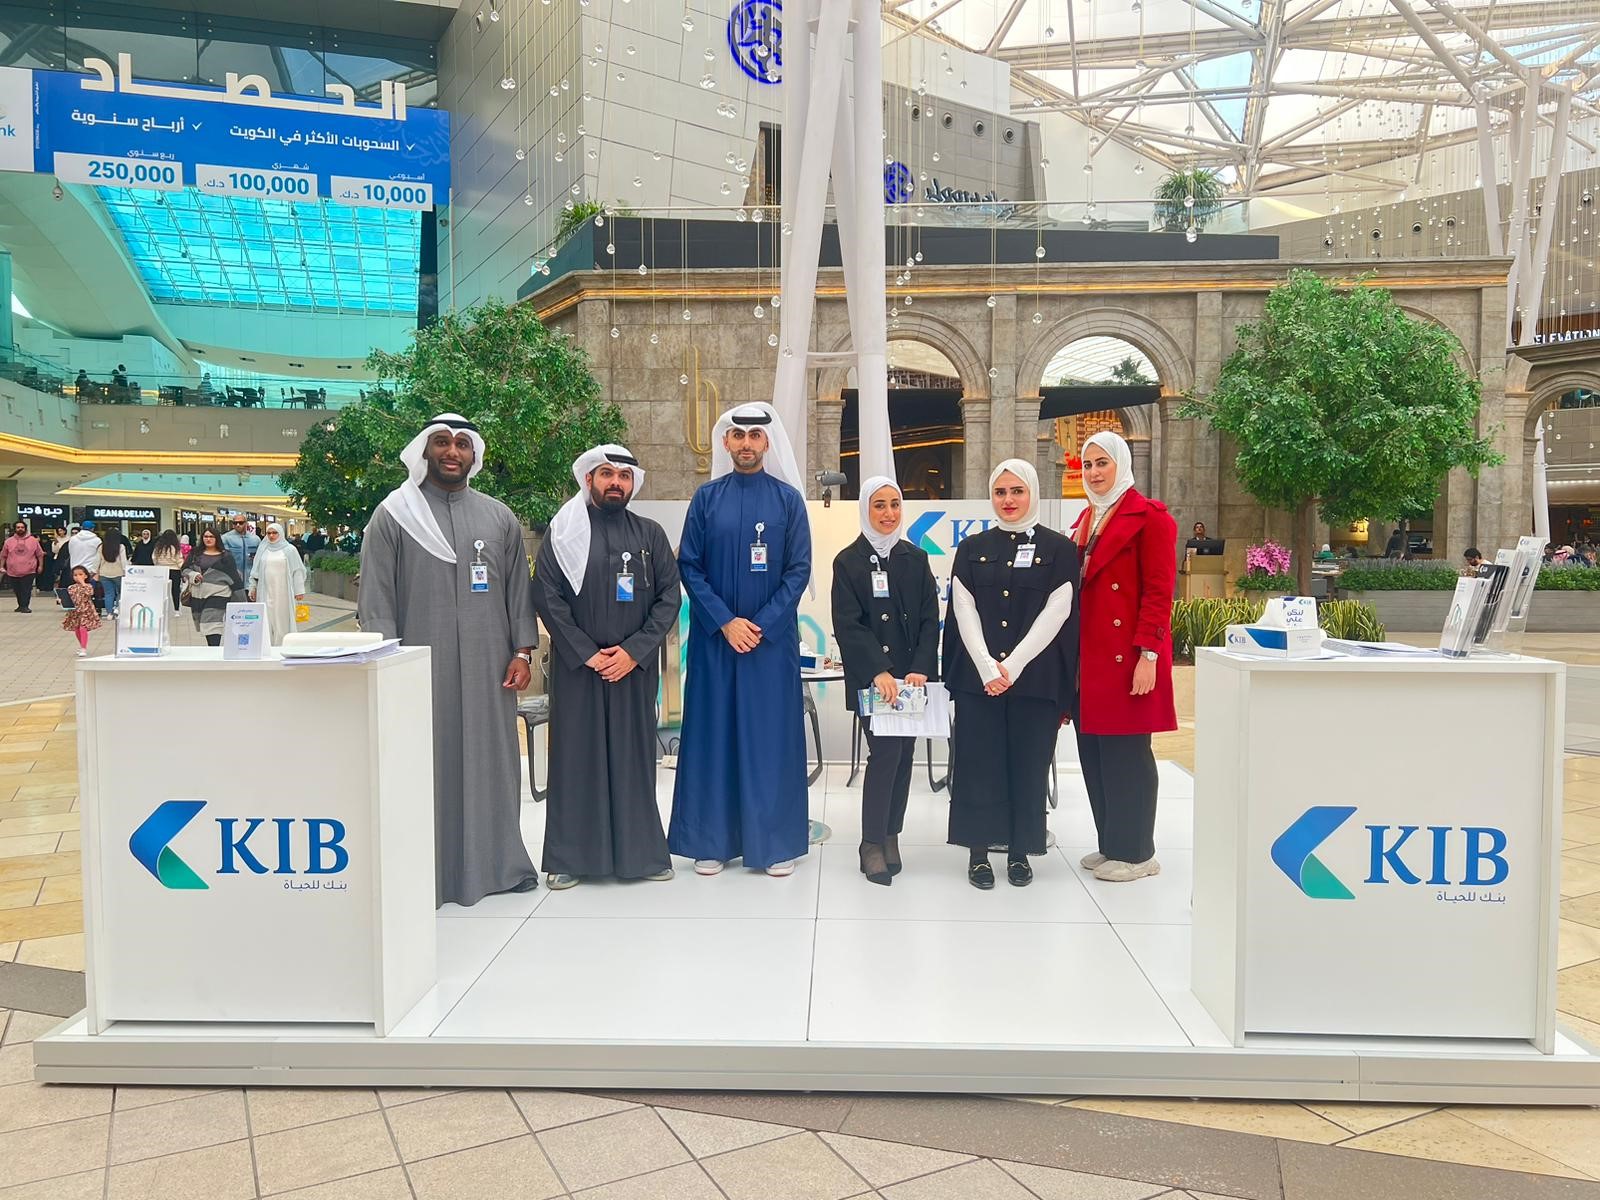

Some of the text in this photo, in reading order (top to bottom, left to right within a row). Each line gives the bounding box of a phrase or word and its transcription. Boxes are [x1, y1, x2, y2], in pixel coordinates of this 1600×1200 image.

[81, 53, 407, 121] الحصاد
[0, 124, 16, 137] nk
[71, 109, 185, 134] أرباح سنوية
[229, 125, 399, 151] السحوبات الأكثر في الكويت
[88, 160, 175, 184] 250,000
[229, 173, 310, 196] 100,000
[363, 184, 427, 205] 10,000
[214, 818, 349, 874] KIB
[1363, 825, 1510, 886] KIB
[284, 880, 347, 892] بنك للحياة
[1436, 891, 1506, 904] بنك للحياة
